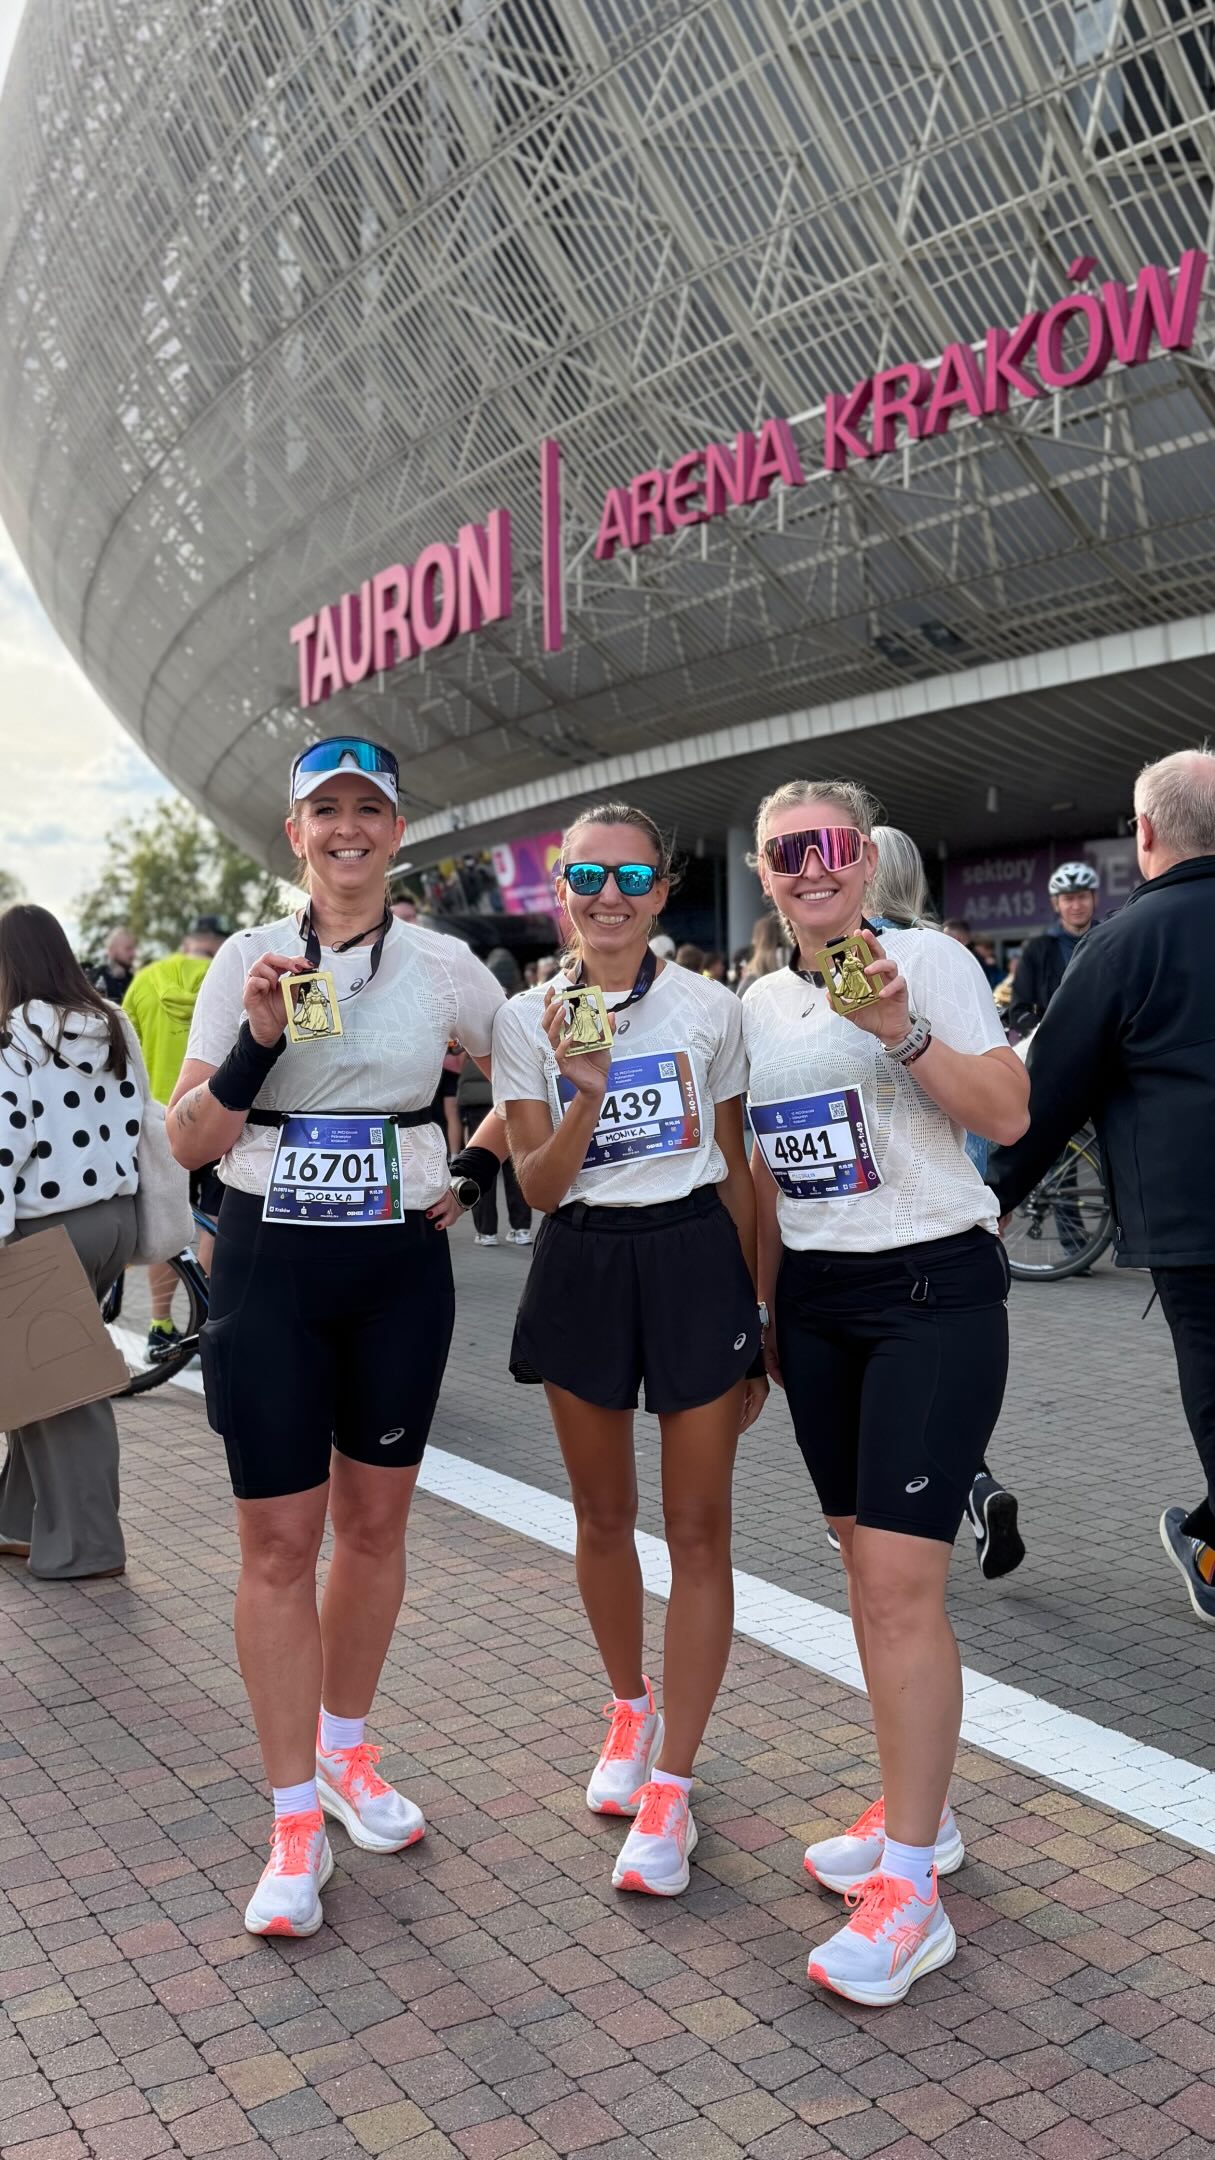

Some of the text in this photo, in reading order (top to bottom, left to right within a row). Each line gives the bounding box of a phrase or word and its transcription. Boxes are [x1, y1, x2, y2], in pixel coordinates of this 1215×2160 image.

[594, 249, 1207, 560] ARENA KRAKÓW
[290, 508, 511, 708] TAURON
[962, 857, 1036, 885] sektory
[599, 1089, 662, 1123] 439
[605, 1128, 647, 1142] MONIKA
[775, 1130, 837, 1163] 4841
[282, 1151, 379, 1183] 16701
[304, 1192, 352, 1202] DORKA
